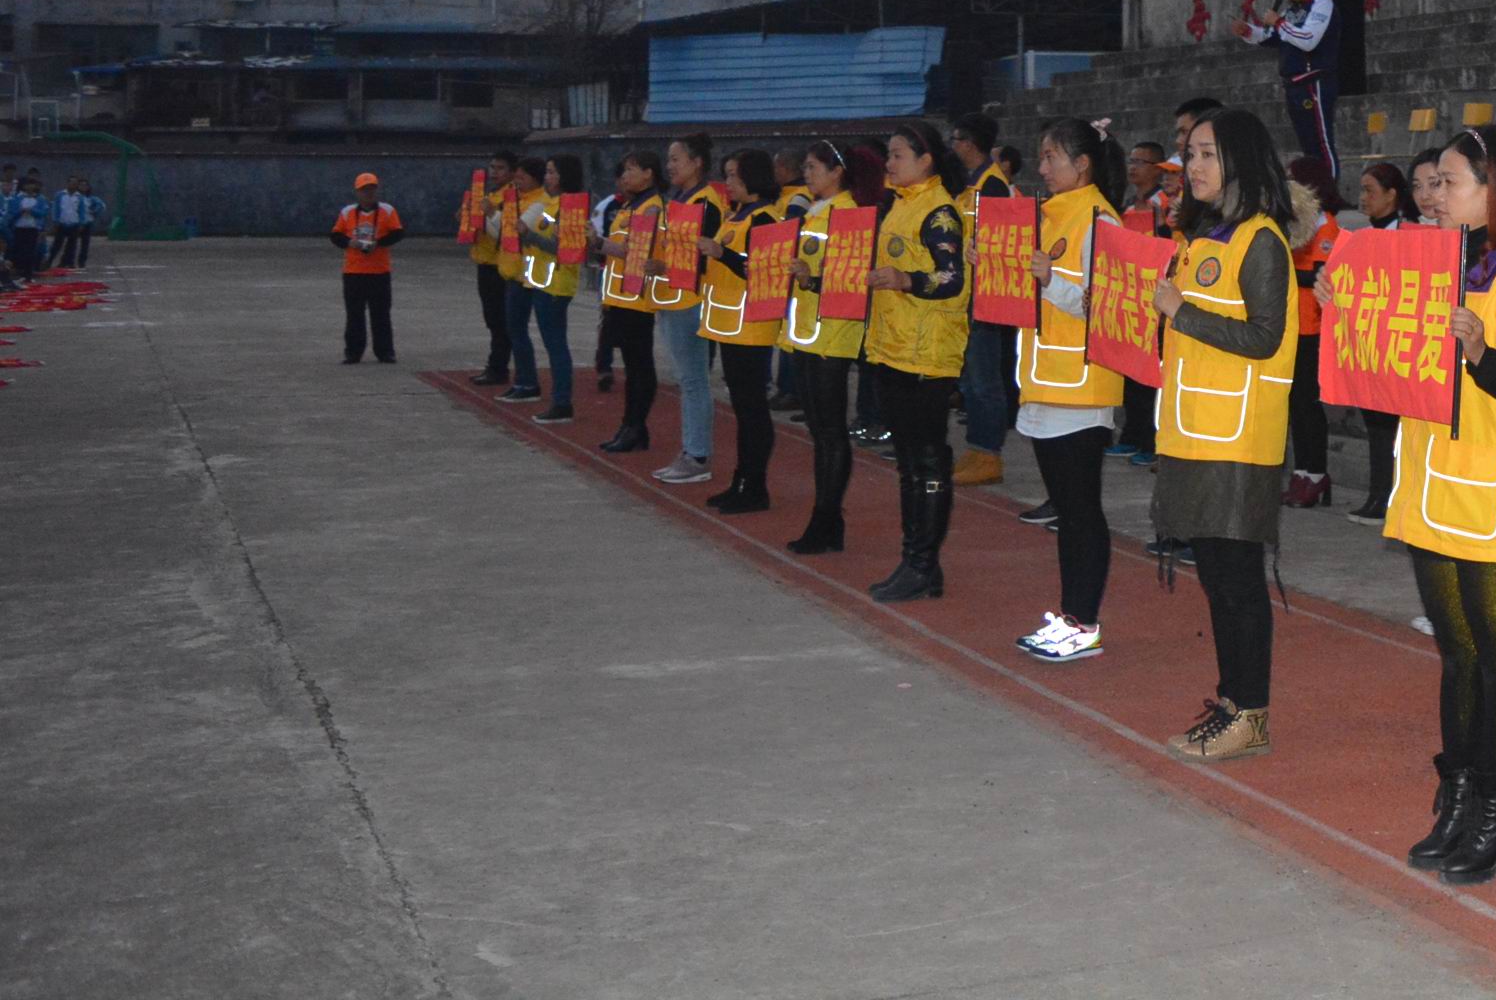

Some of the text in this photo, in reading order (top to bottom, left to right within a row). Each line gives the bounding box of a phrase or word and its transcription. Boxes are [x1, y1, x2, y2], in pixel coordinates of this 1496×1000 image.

[1090, 249, 1158, 356] 我就是爱
[1330, 262, 1453, 385] 我就是爱
